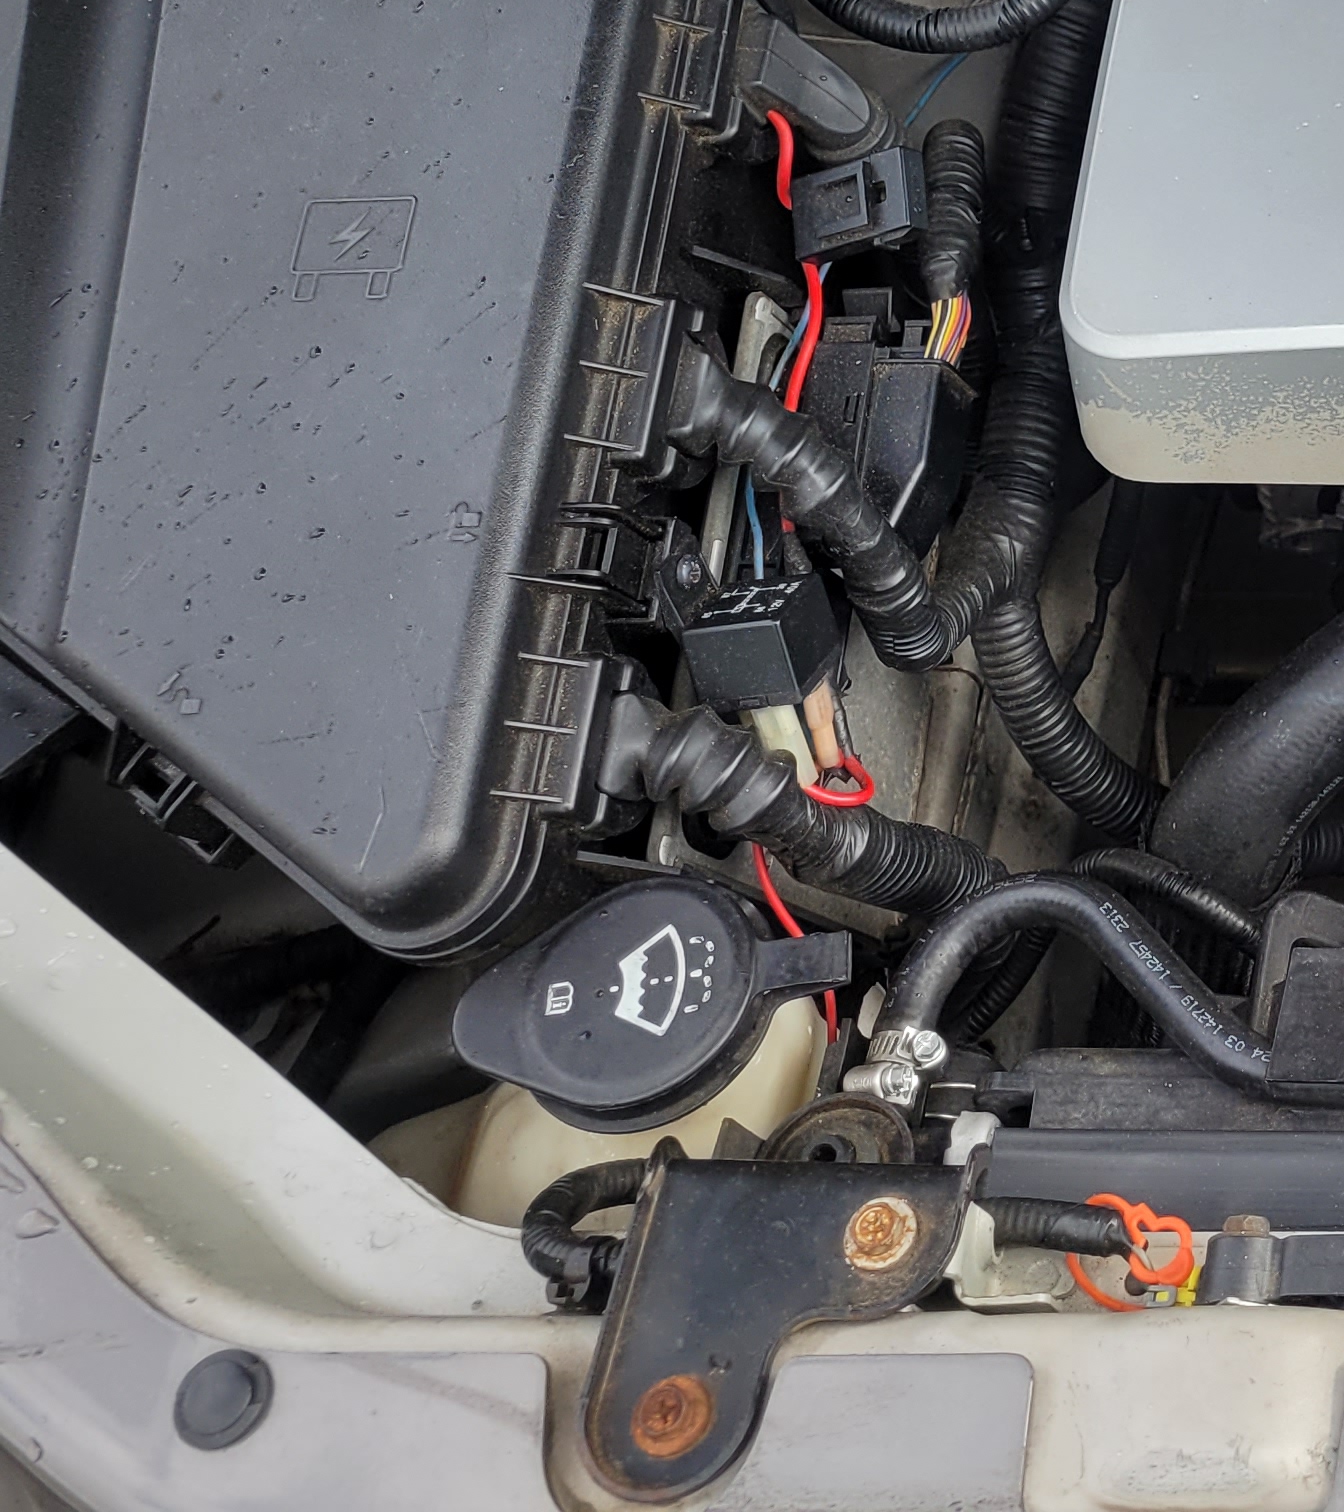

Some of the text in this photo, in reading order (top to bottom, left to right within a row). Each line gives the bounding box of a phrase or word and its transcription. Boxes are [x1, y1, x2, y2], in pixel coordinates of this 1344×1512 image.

[1099, 902, 1129, 933] 2313
[1129, 940, 1171, 980] 142457
[1181, 995, 1223, 1035] 142719
[1224, 1035, 1245, 1052] 03
